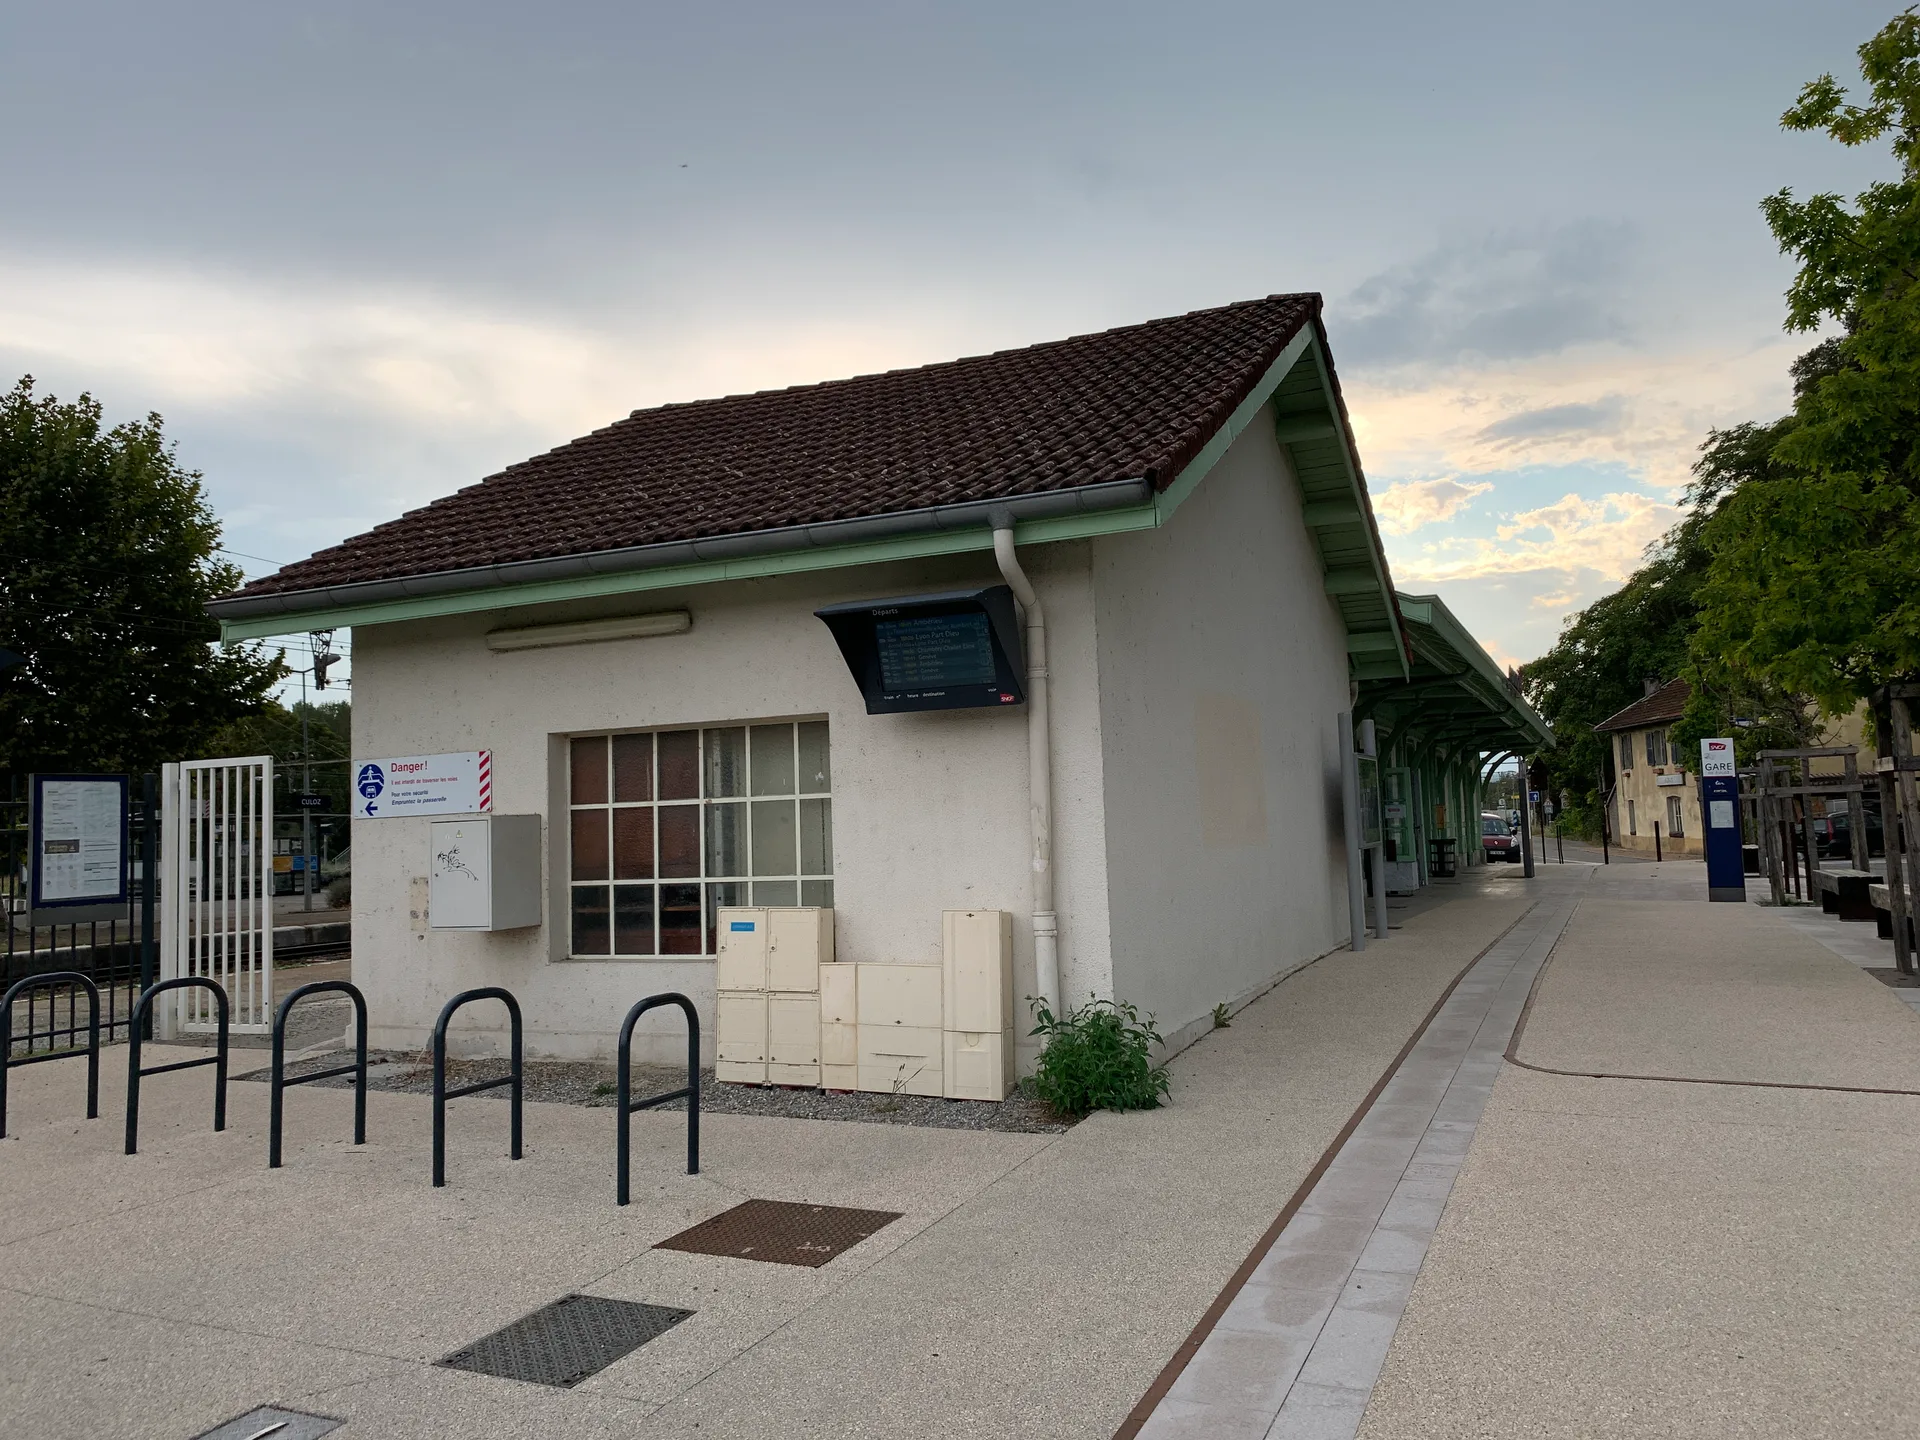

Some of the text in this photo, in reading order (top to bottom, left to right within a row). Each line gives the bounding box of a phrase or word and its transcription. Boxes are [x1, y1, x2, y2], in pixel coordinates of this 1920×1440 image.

[872, 607, 898, 616] Départs
[391, 760, 428, 774] Danger!
[1705, 762, 1733, 771] GARE
[422, 796, 447, 804] passerelle
